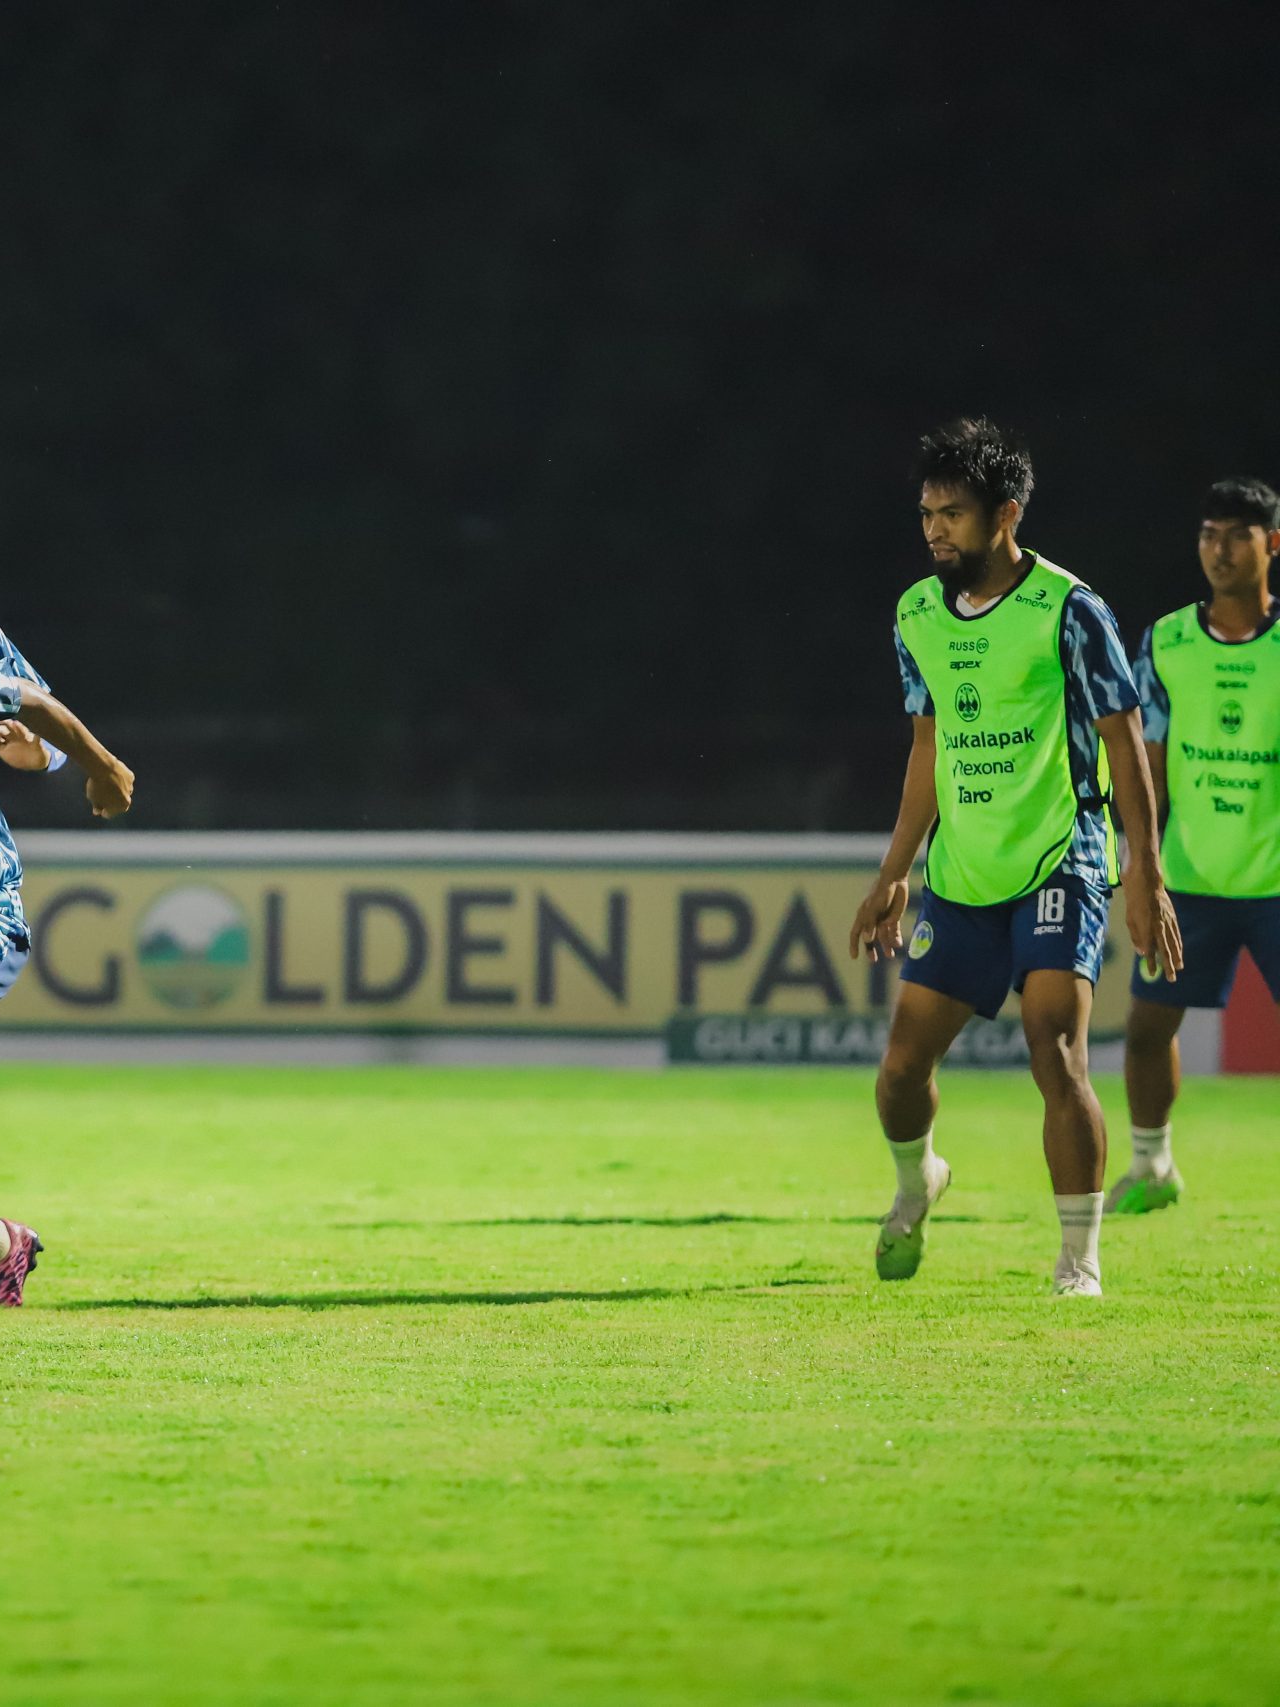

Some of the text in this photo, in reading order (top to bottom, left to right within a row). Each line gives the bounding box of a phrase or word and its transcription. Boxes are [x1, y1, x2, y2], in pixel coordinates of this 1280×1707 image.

[1015, 594, 1054, 612] bmoney
[949, 641, 975, 651] RUSS
[950, 660, 982, 671] apex
[1037, 888, 1066, 924] 18
[1034, 926, 1064, 935] apex
